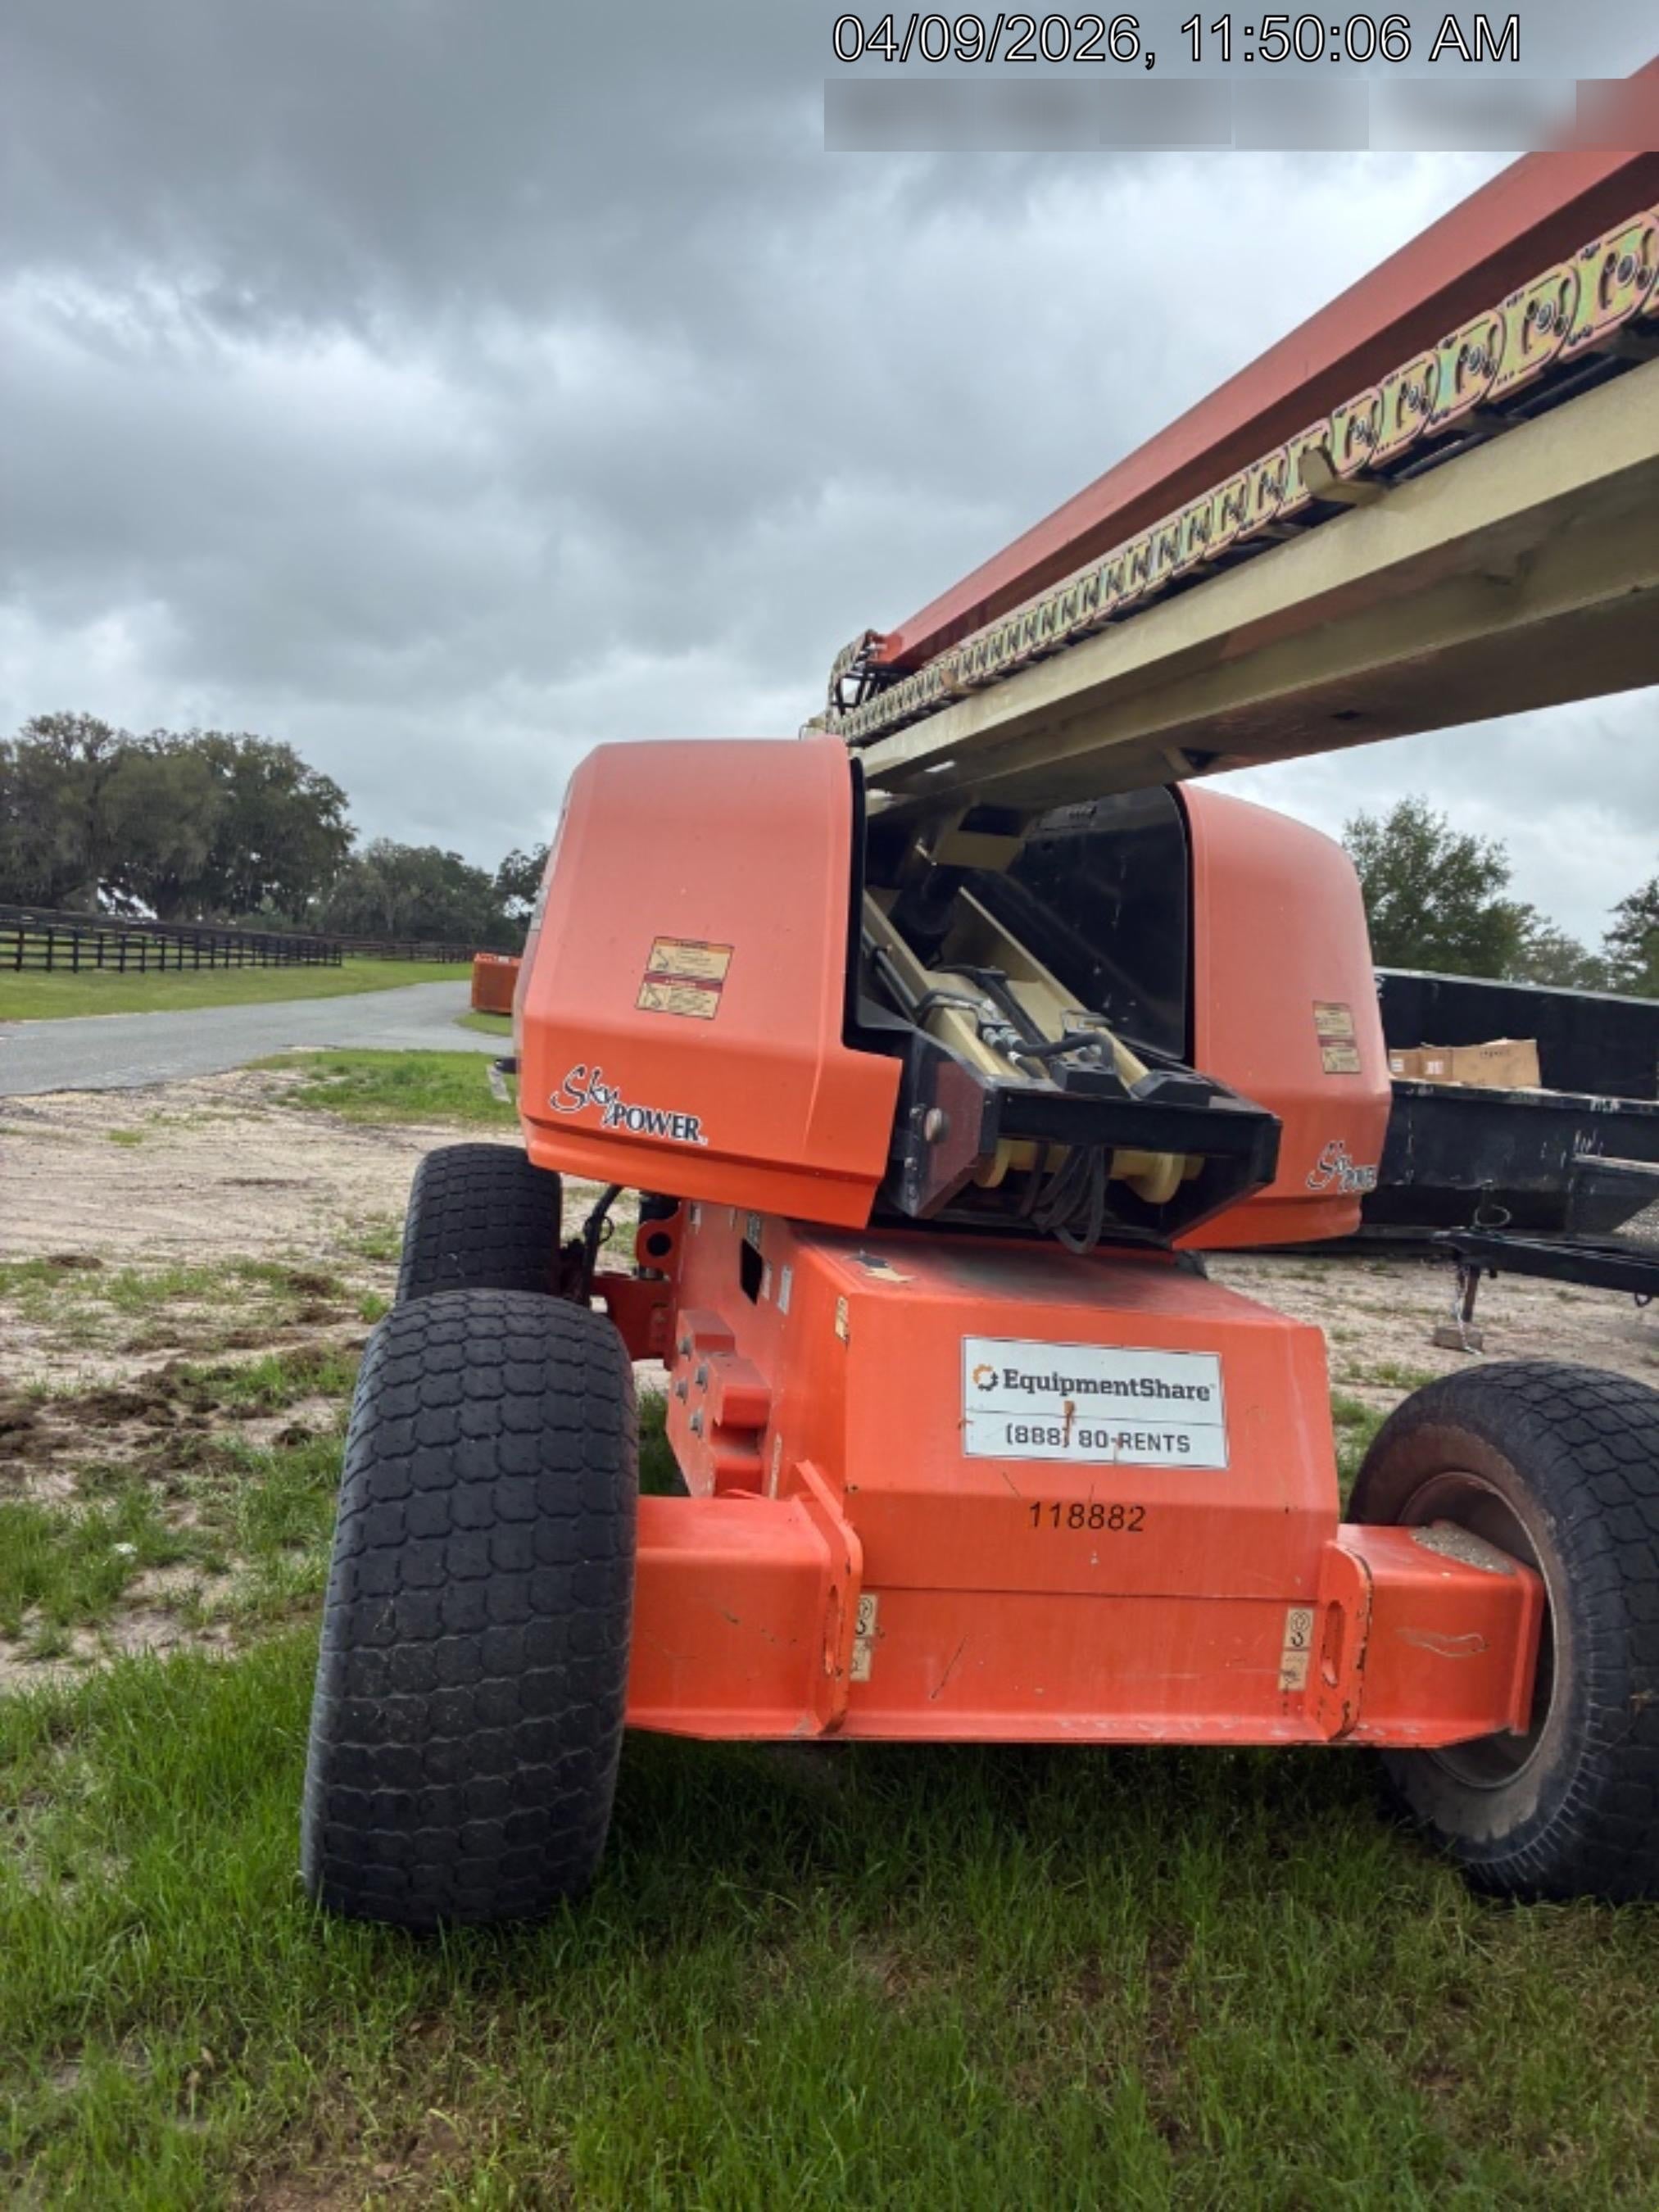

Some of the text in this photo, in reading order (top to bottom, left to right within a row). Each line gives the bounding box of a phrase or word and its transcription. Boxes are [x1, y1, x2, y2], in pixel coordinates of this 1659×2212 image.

[612, 1103, 701, 1141] POWER
[1002, 1368, 1211, 1401] EquipmentShare
[1006, 1423, 1190, 1453] (888) 80-RENTS
[1029, 1501, 1146, 1531] 118882
